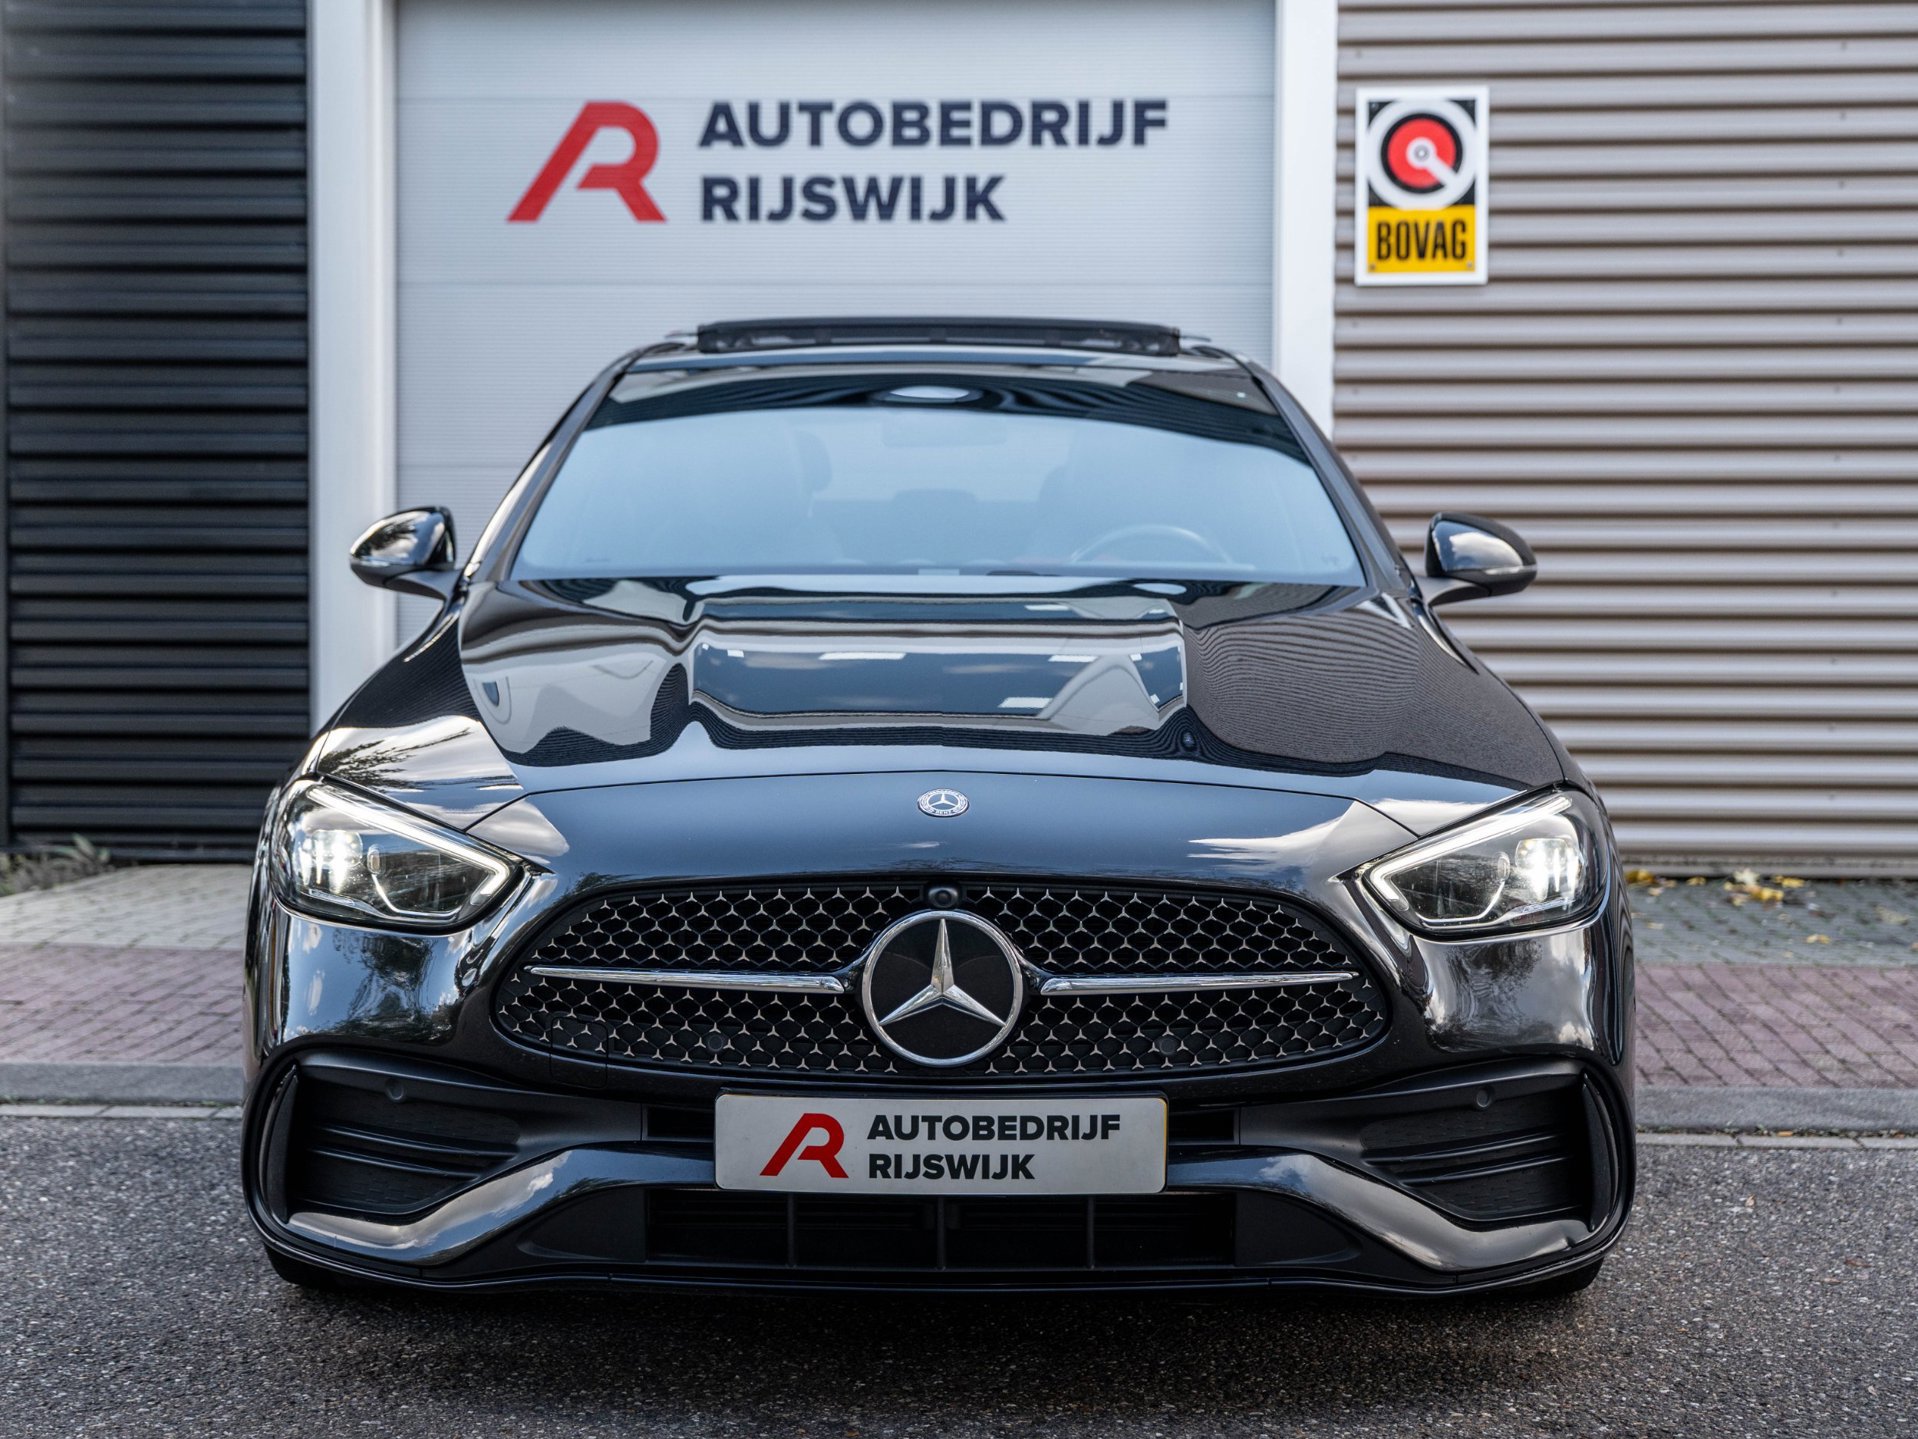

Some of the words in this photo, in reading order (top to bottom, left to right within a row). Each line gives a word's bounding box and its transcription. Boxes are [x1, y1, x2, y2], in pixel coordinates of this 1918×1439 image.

[697, 99, 1169, 148] AUTOBEDRIJF
[700, 175, 1006, 222] RIJSWIJK
[1376, 219, 1468, 261] BOVAG
[866, 1114, 1121, 1142] AUTOBEDRIJF
[867, 1153, 1036, 1181] RIJSWIJK
